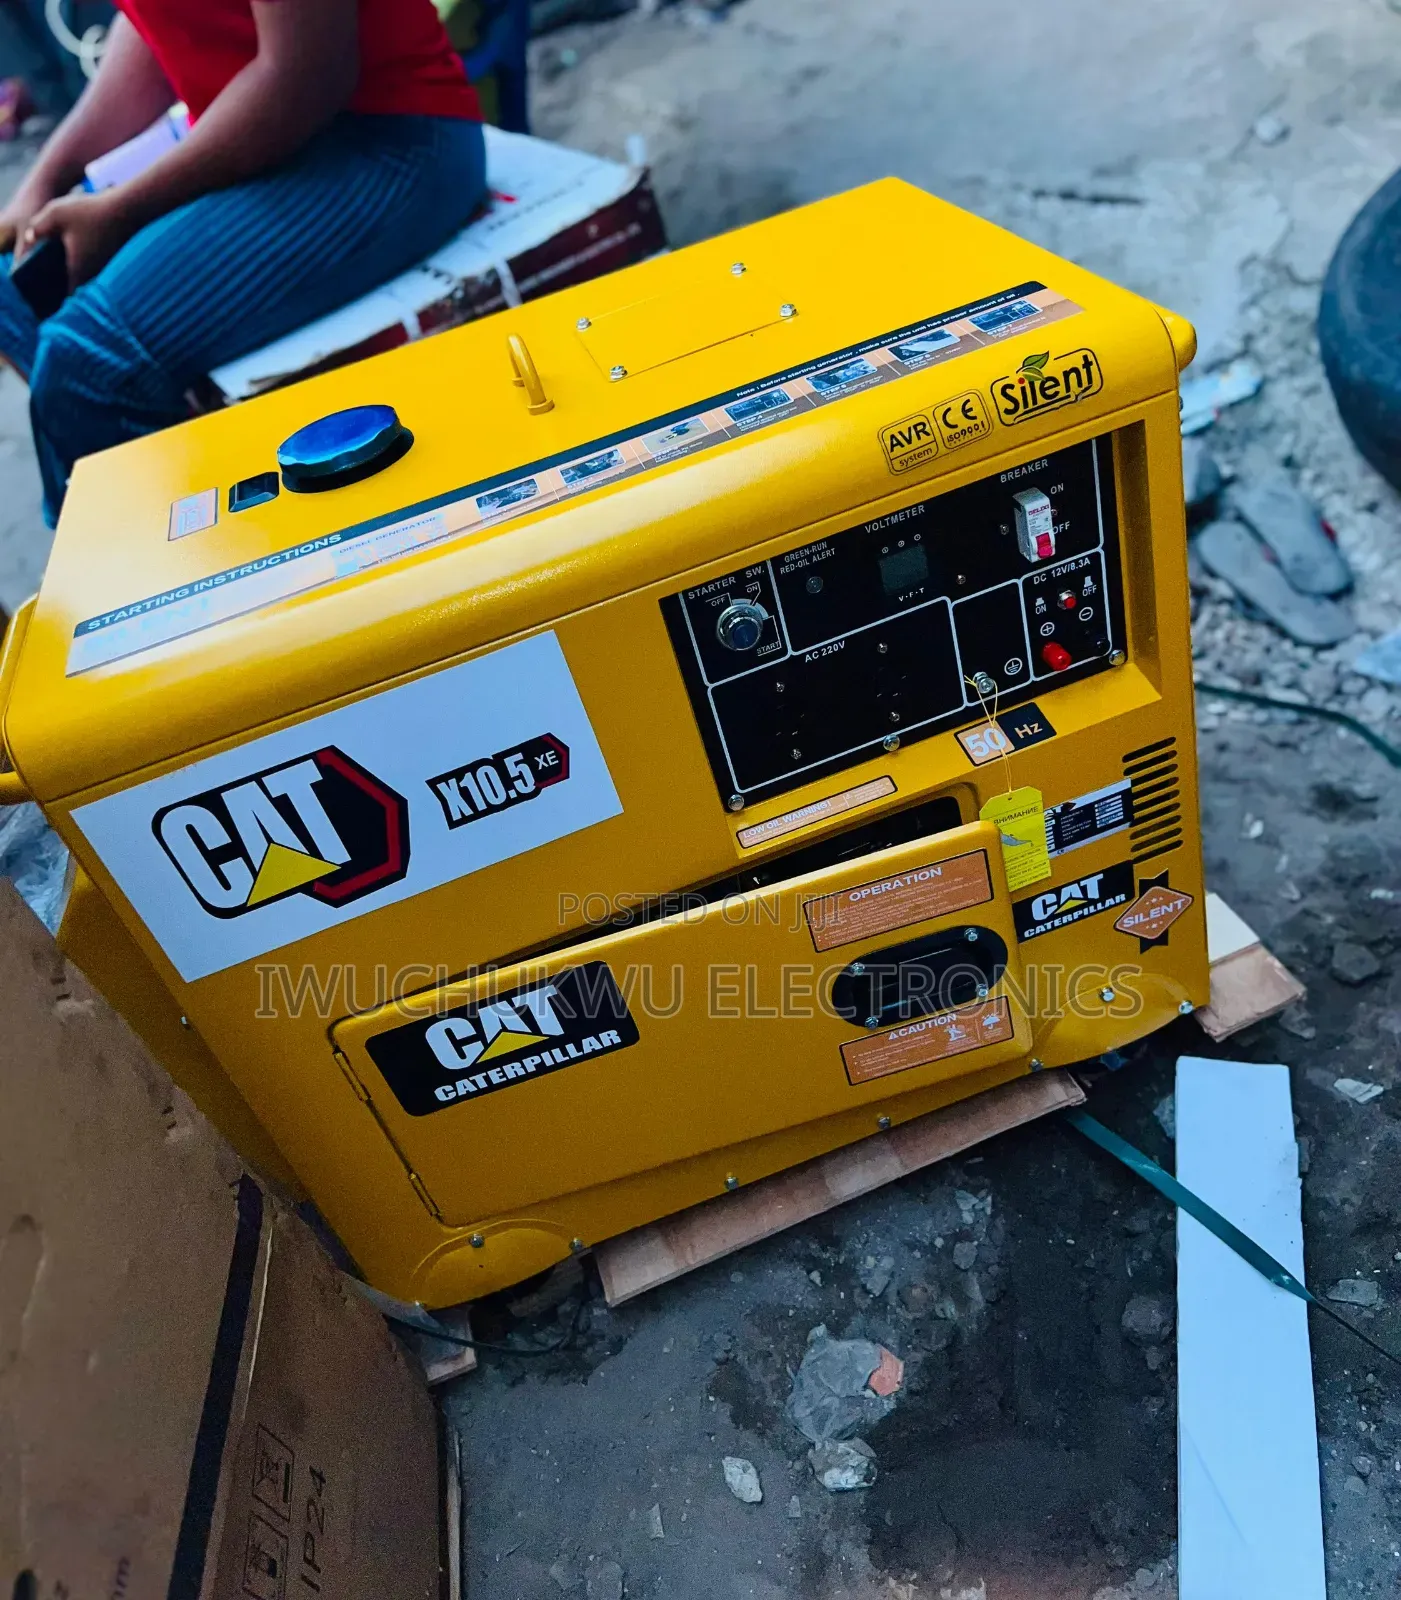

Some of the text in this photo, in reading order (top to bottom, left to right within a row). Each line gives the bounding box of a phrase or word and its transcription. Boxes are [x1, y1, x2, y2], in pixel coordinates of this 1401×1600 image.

[1000, 354, 1094, 416] Silent
[889, 421, 931, 453] AVR
[899, 447, 933, 467] system
[1000, 458, 1050, 484] BREAKER
[1051, 483, 1064, 494] ON
[864, 504, 926, 534] VOLTMETER
[779, 547, 836, 575] RED-OIL ALERT
[784, 540, 828, 563] GREEN-RUN
[88, 588, 190, 630] STARTING
[193, 533, 343, 593] INSTRUCTIONS
[688, 565, 766, 600] STARTER SW.
[1033, 558, 1091, 585] DC 12V/8.3A
[711, 597, 726, 607] OFF
[746, 584, 759, 594] ON
[1082, 585, 1098, 597] OFF
[1035, 604, 1047, 615] ON
[756, 640, 780, 654] START
[804, 640, 847, 663] AC 220V
[965, 722, 1044, 757] 50 Hz
[436, 750, 560, 822] X10.5 XE
[160, 758, 352, 909] CAT
[743, 799, 832, 838] LOW OIL WARNING!
[849, 866, 943, 902] OPERATION
[1031, 873, 1104, 921] CAT
[1024, 893, 1126, 939] CATERPILLAR
[1123, 898, 1186, 928] SILENT
[425, 984, 565, 1070] CAT
[898, 1013, 957, 1037] CAUTION
[434, 1030, 622, 1102] CATERPILLAR
[301, 1465, 328, 1593] IP24
